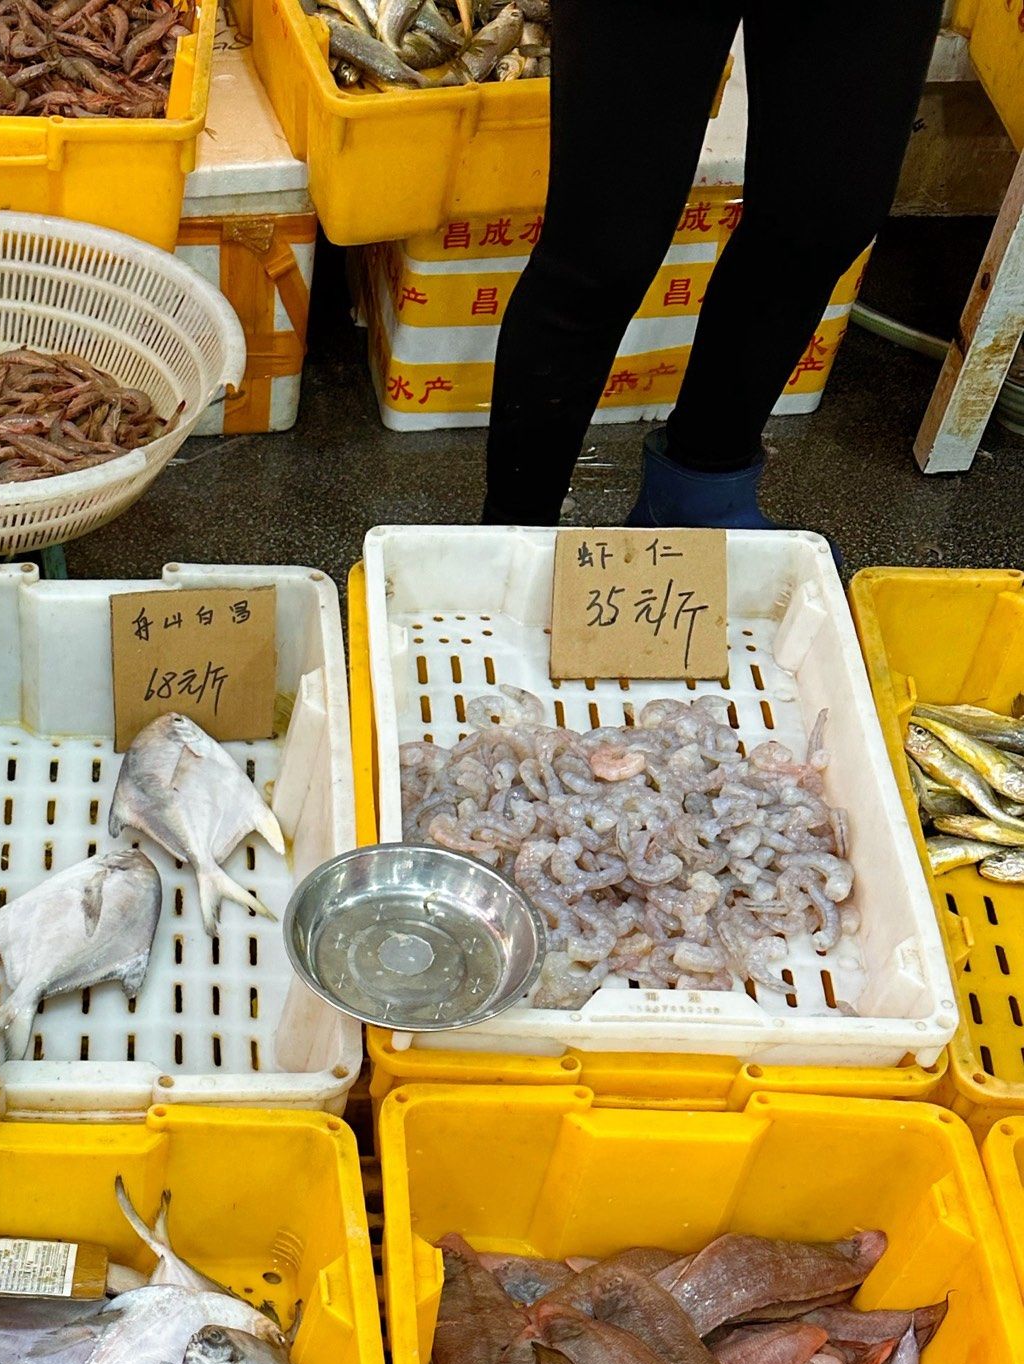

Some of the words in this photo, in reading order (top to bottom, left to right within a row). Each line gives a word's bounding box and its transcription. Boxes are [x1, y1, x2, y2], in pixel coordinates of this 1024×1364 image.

[471, 287, 498, 315] 昌
[663, 278, 691, 306] 昌
[387, 375, 453, 405] 水产
[577, 538, 683, 569] 虾仁
